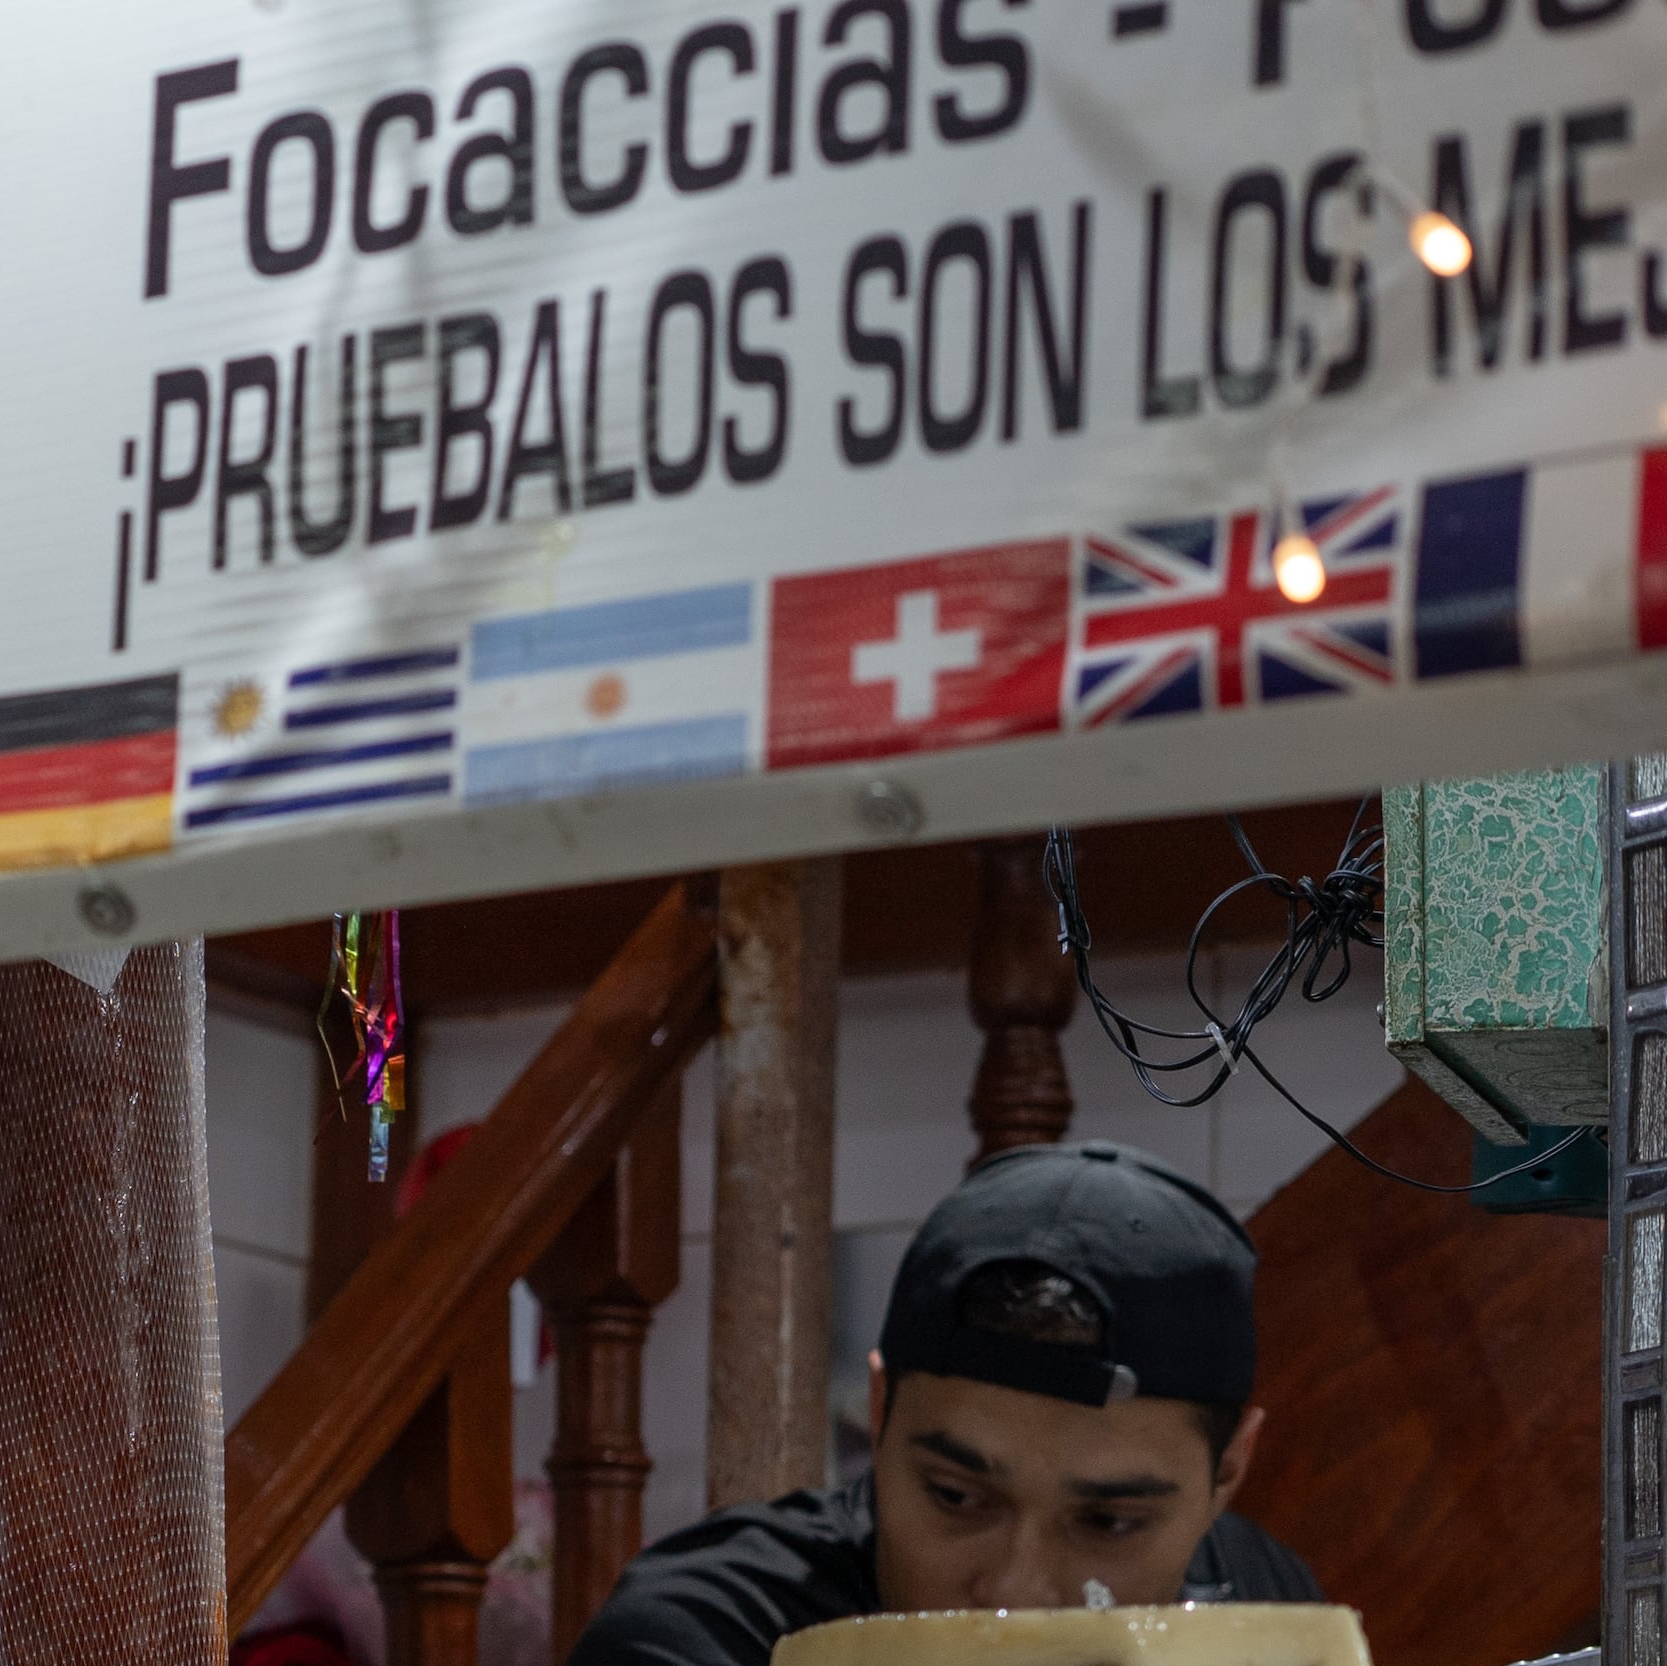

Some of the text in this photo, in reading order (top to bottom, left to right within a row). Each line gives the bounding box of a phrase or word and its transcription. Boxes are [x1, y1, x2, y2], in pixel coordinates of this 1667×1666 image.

[143, 0, 1033, 299] Focaccias
[112, 254, 792, 651] ¡PRUEBALOS
[836, 200, 1091, 468] SON
[1140, 150, 1373, 424] LOS
